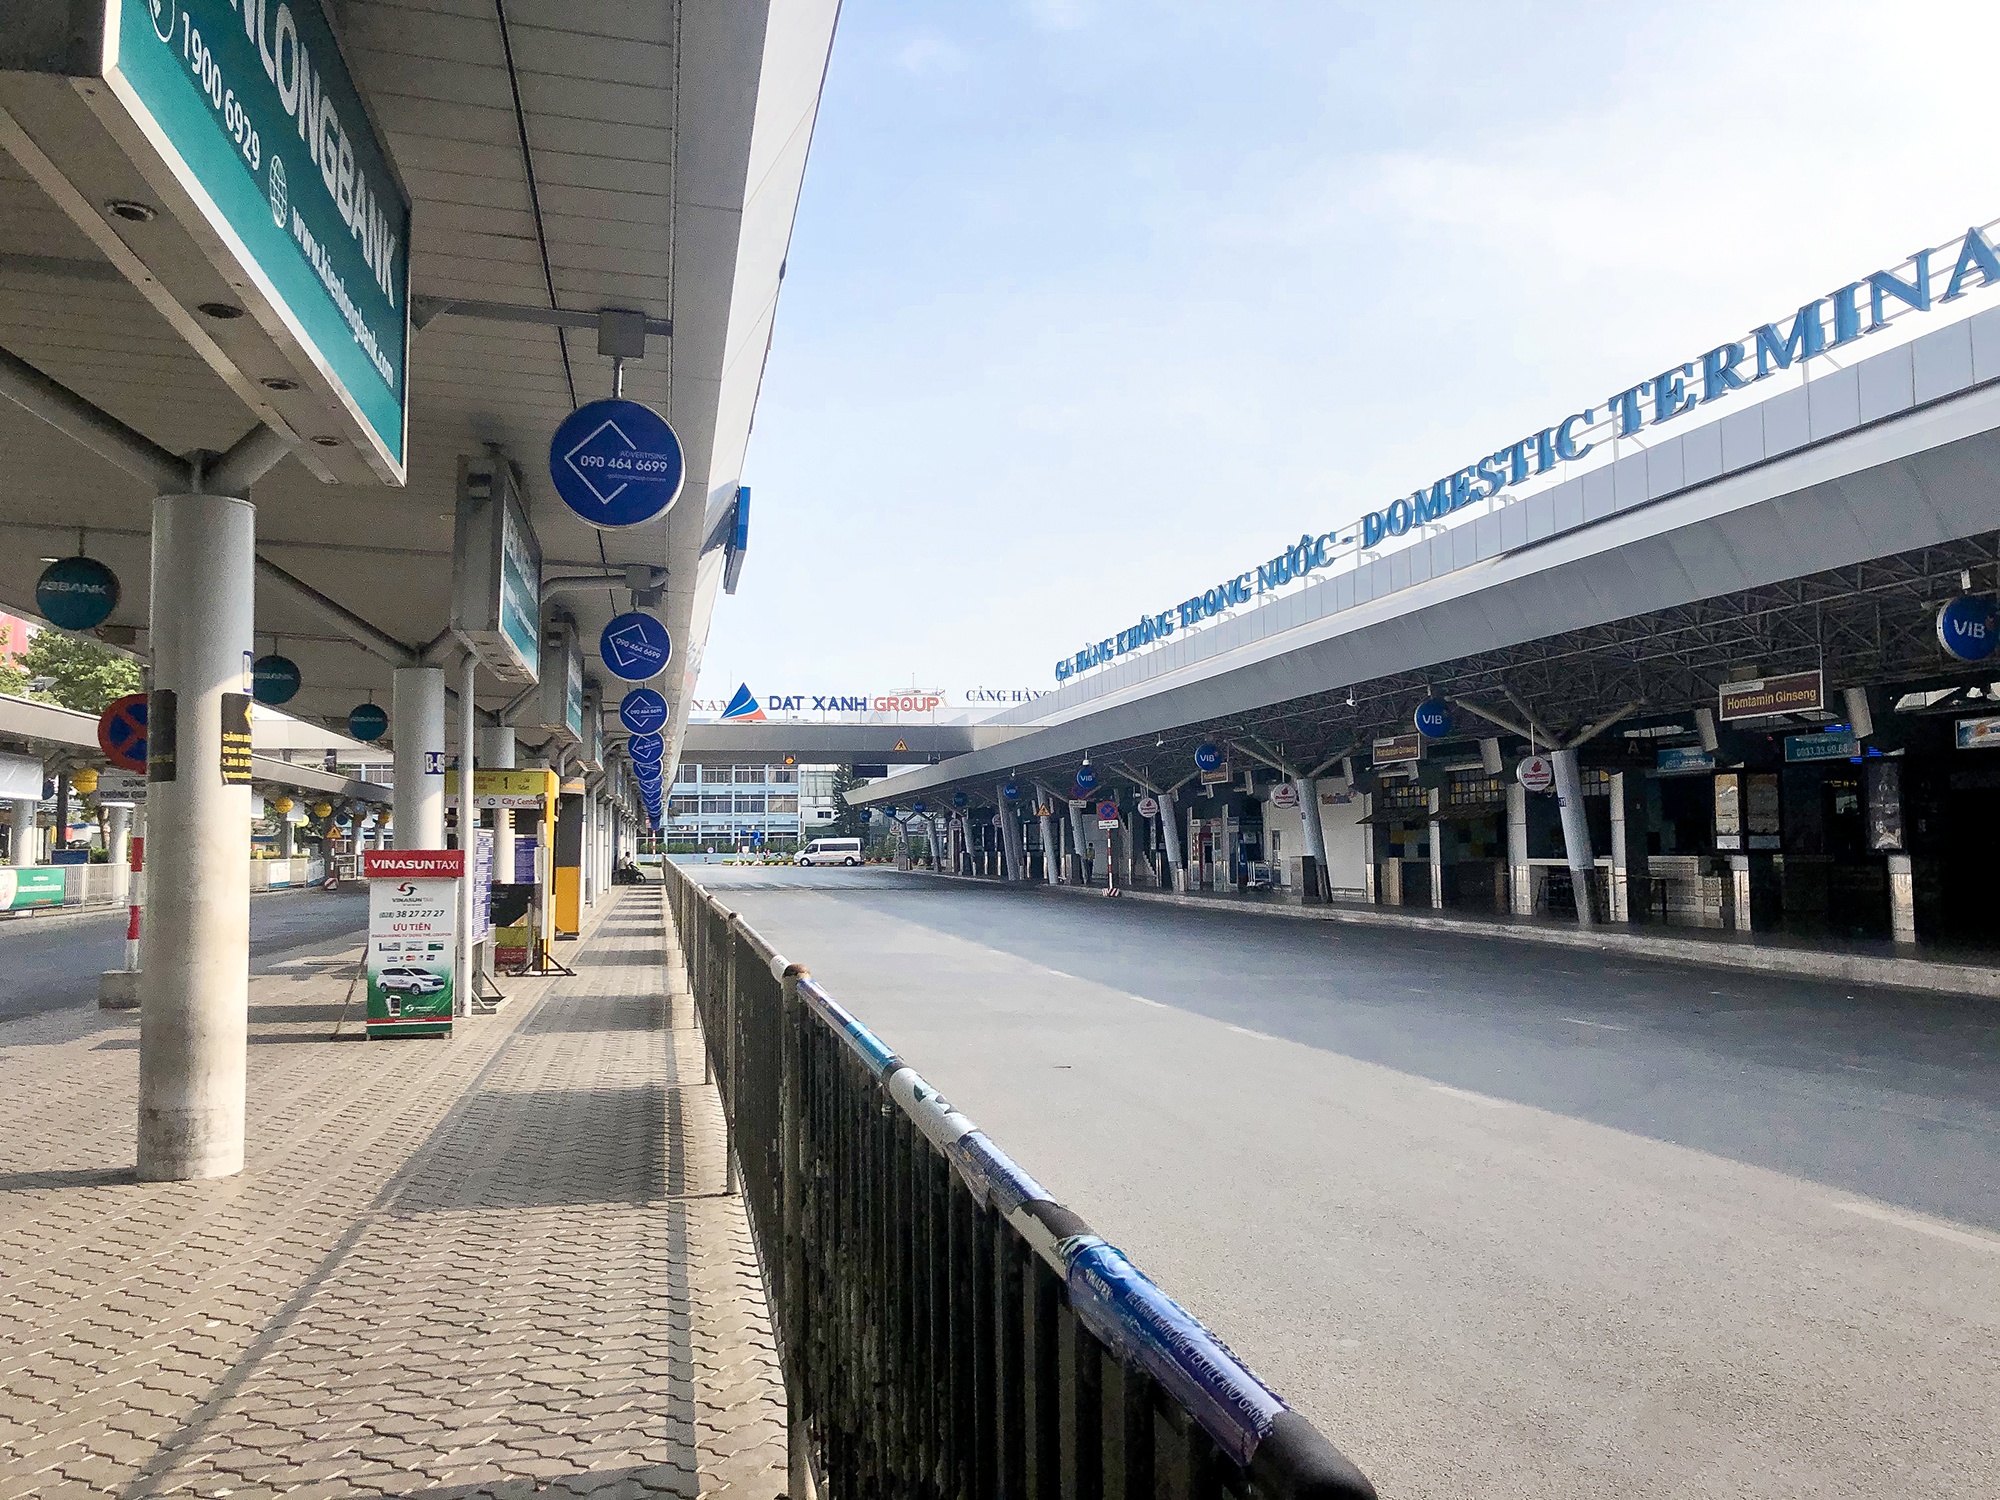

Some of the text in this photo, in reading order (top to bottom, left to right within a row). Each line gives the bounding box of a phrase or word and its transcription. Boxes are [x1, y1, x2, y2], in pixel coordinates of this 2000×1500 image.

[182, 11, 260, 171] 1900 6929
[620, 450, 668, 461] ADVERTISING
[1055, 658, 1074, 681] GA
[1075, 638, 1115, 673] HÀNG
[1116, 609, 1175, 656] KHÔNG
[1177, 572, 1252, 629] TRONG
[1256, 532, 1337, 594] NƯỚC
[1361, 408, 1595, 550] DOMESTIC
[1608, 225, 2000, 440] TERMINA
[580, 455, 668, 473] 090 464 6699
[1953, 619, 1986, 639] VIB
[965, 685, 1007, 702] CẢNG
[1727, 689, 1817, 710] Homtamin Ginseng
[769, 695, 940, 712] DAT XANH GROUP
[1422, 714, 1443, 725] VIB
[1200, 754, 1215, 762] VIB
[503, 776, 509, 790] 1
[501, 797, 516, 806] City
[396, 910, 407, 918] 38
[408, 910, 420, 918] 27
[420, 910, 432, 918] 27
[433, 910, 445, 918] 27
[1152, 1313, 1194, 1355] NATIONAL
[1187, 1342, 1225, 1382] TEXTILE
[1216, 1374, 1245, 1400] AND
